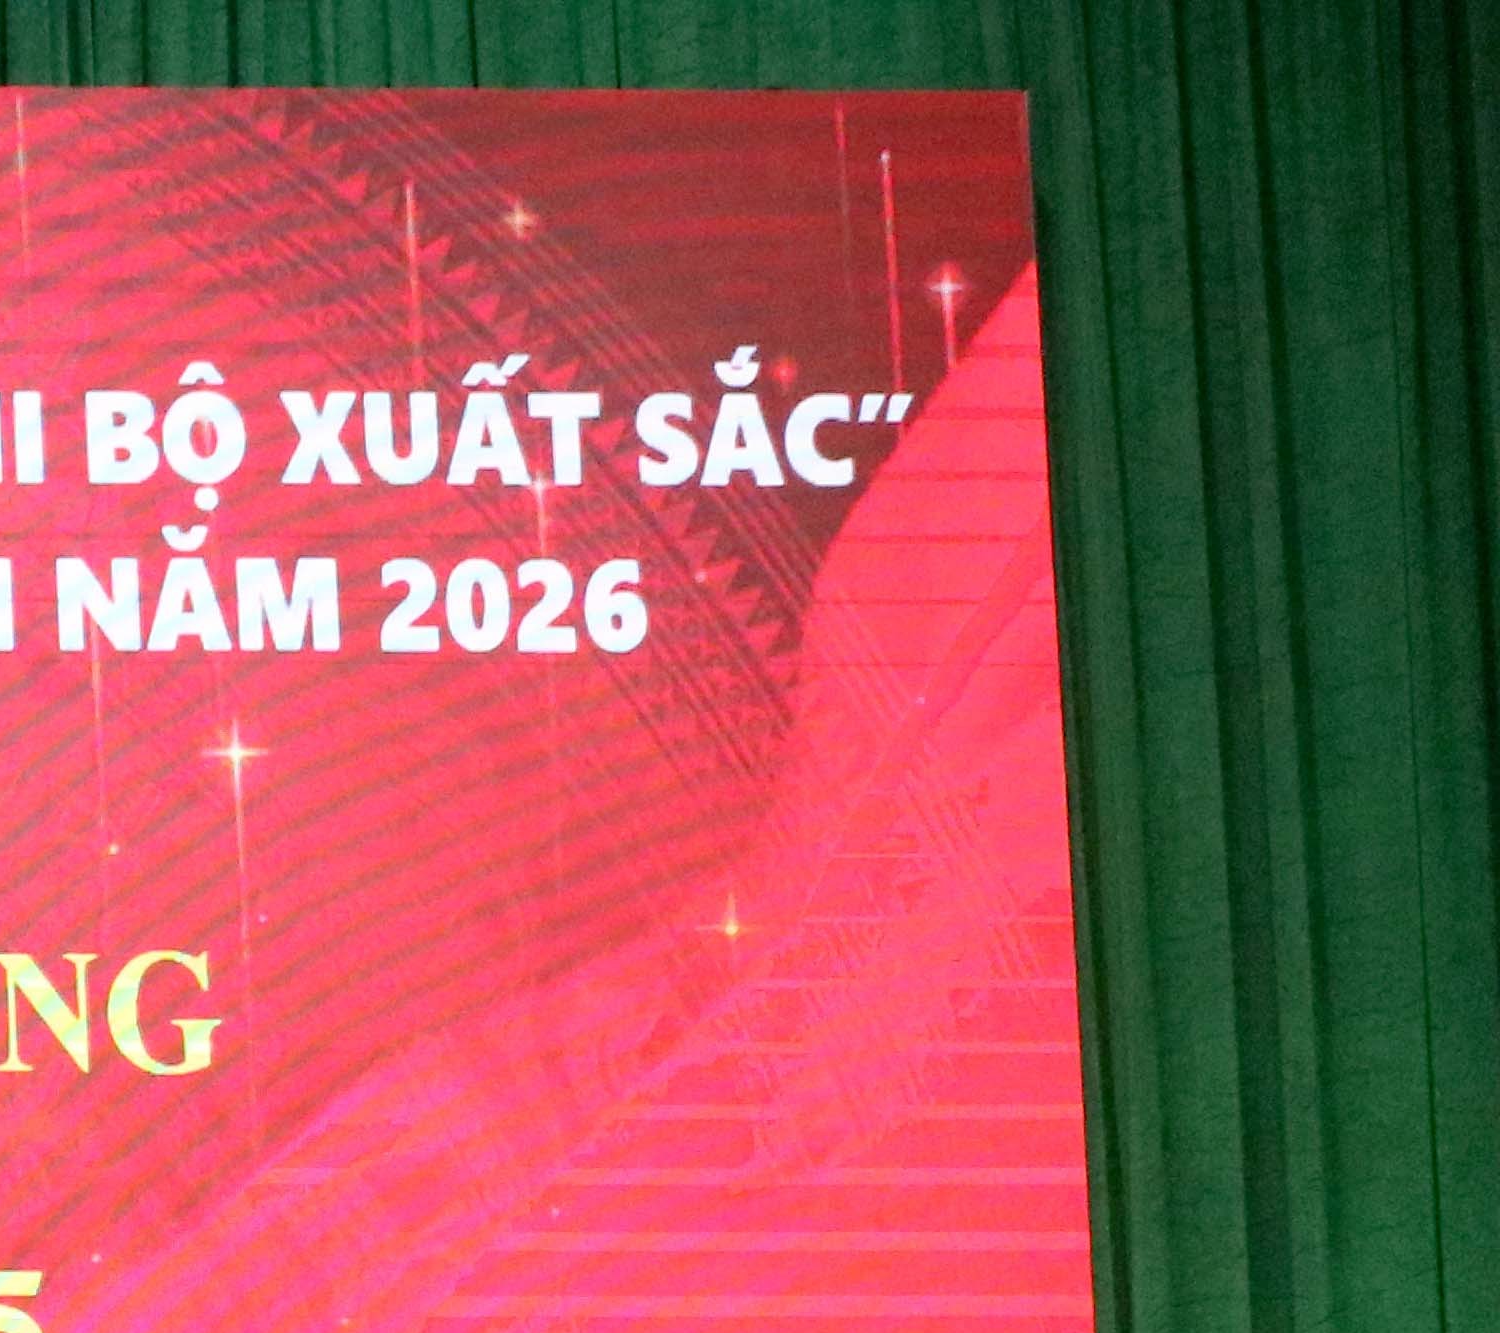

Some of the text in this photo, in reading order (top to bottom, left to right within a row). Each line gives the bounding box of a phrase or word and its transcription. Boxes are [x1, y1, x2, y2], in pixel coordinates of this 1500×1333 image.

[86, 362, 246, 510] BỘ
[281, 355, 599, 485] XUẤT
[56, 526, 339, 650] NĂM
[381, 559, 647, 652] 2026
